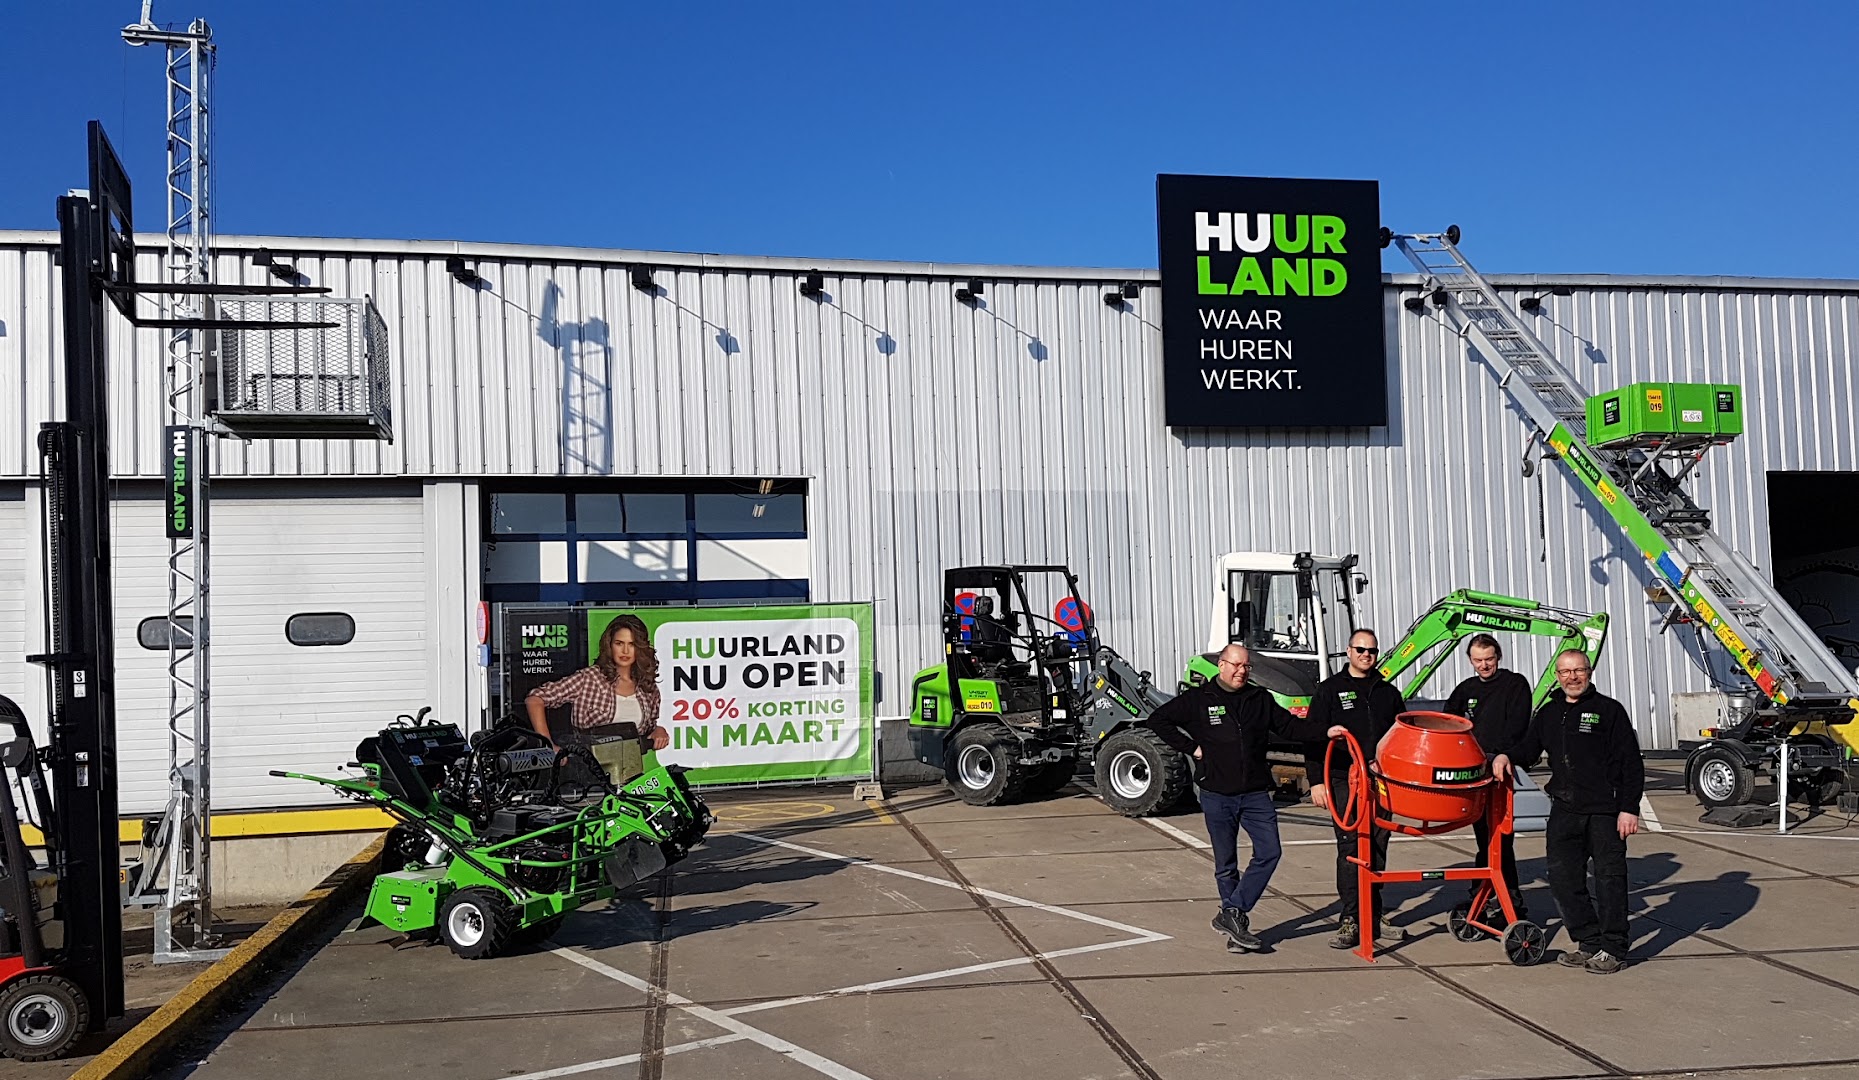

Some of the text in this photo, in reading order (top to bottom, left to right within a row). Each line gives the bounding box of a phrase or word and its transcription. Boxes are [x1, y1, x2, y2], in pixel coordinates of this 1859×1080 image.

[1195, 211, 1347, 253] HUUR
[1197, 255, 1348, 296] LAND
[1199, 309, 1282, 330] WAAR
[1200, 339, 1292, 360] HUREN
[1200, 369, 1302, 390] WERKT.
[1650, 402, 1662, 411] 019
[1569, 445, 1599, 481] HUURLAND
[173, 431, 186, 532] HUURLAND
[521, 624, 568, 637] HUUR
[1465, 612, 1527, 631] HUURLAND
[522, 636, 568, 648] LAND
[672, 634, 845, 660] HUURLAND
[522, 650, 548, 658] WAAR
[522, 666, 554, 674] WERKT.
[673, 660, 845, 691] NU OPEN
[672, 698, 845, 721] 20% KORTING
[1107, 688, 1138, 714] HUURLAND
[673, 718, 845, 750] IN MAART
